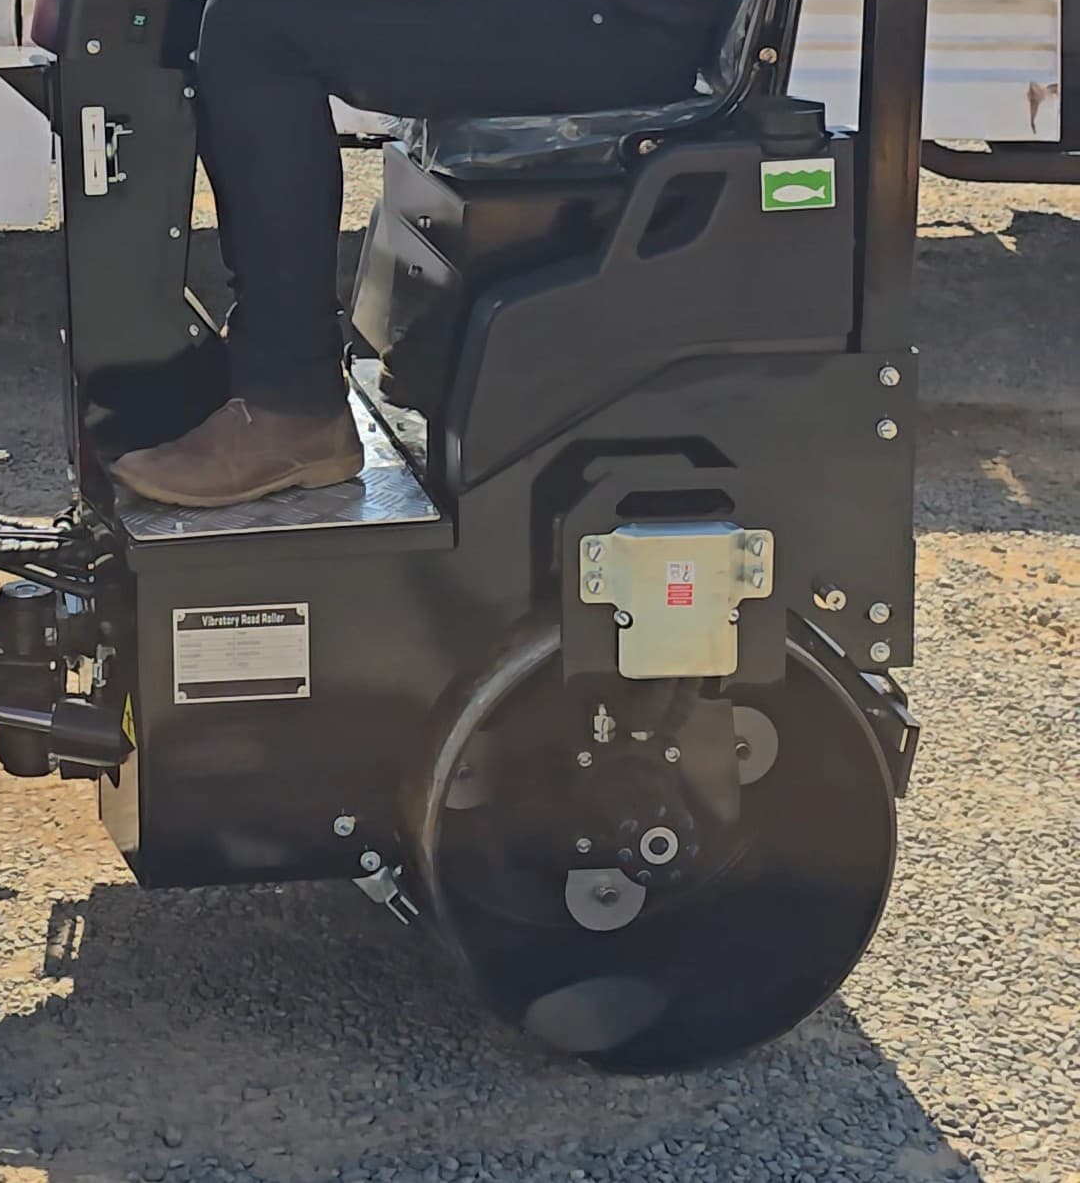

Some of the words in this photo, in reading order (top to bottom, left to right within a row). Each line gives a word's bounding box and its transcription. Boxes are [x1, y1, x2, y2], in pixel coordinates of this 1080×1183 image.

[201, 615, 240, 627] Vibratory
[241, 614, 260, 625] Road
[261, 612, 285, 624] Roller
